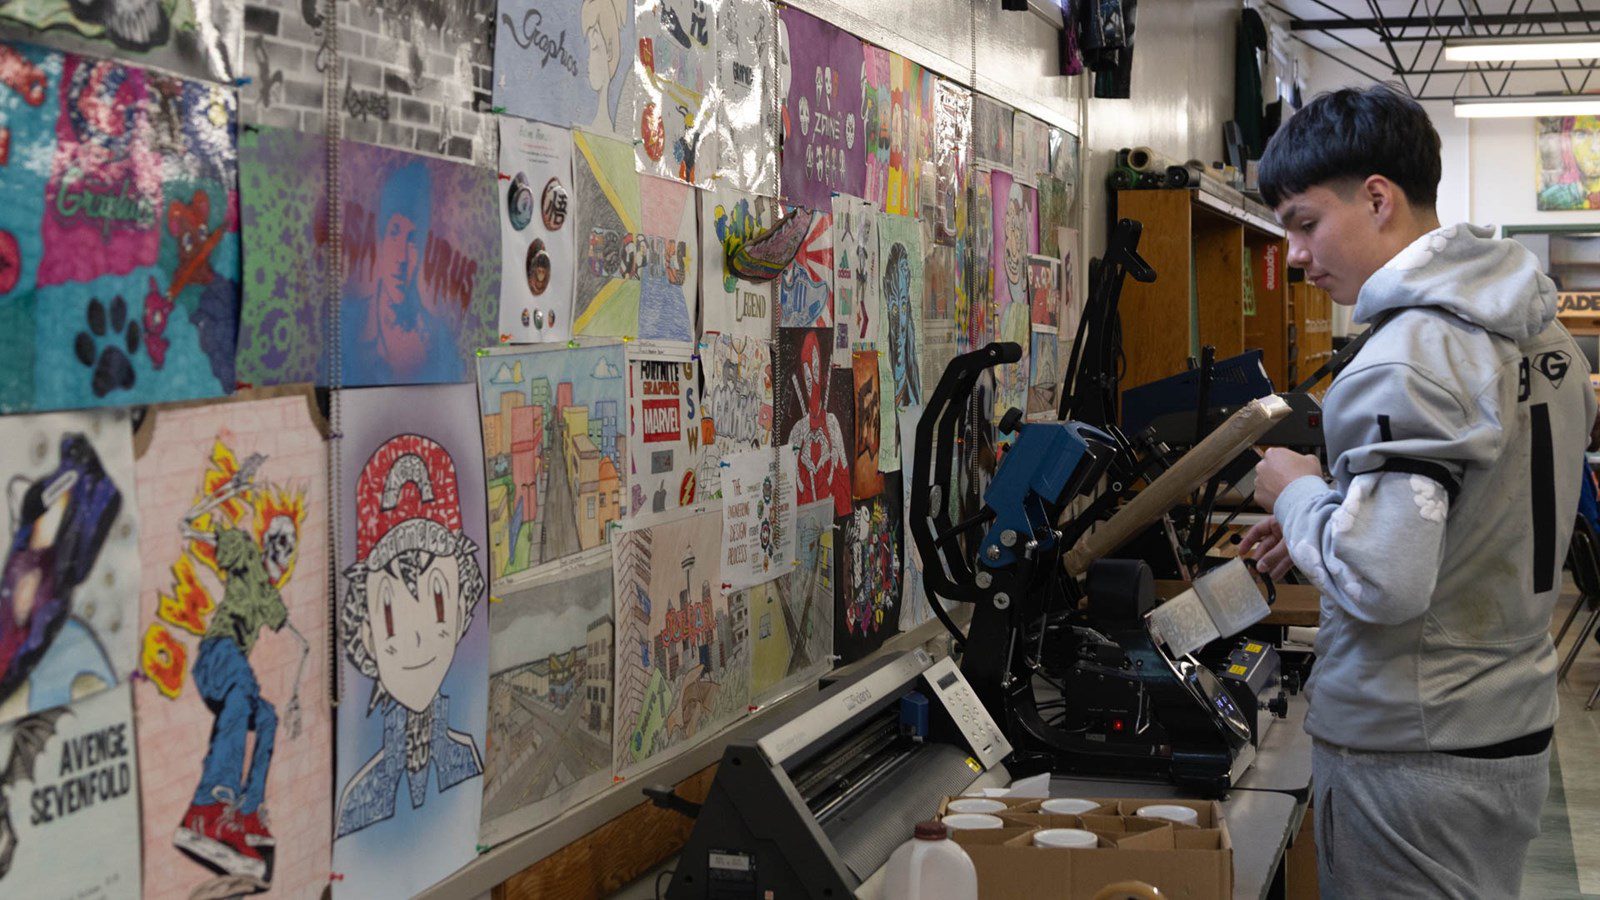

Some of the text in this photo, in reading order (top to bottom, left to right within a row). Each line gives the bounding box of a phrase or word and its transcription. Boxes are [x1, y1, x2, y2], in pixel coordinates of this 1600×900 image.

[502, 9, 578, 77] Graphics
[1264, 244, 1278, 291] Supreme
[735, 287, 767, 322] LEGEND
[641, 360, 679, 382] FORTNITE
[1541, 351, 1568, 381] G
[643, 381, 680, 395] GRAPHICS
[643, 407, 680, 434] MARVEL
[730, 522, 747, 542] DESIGN
[728, 544, 748, 566] PROCESS
[59, 722, 128, 777] AVENGE
[31, 762, 131, 826] SEVENFOLD
